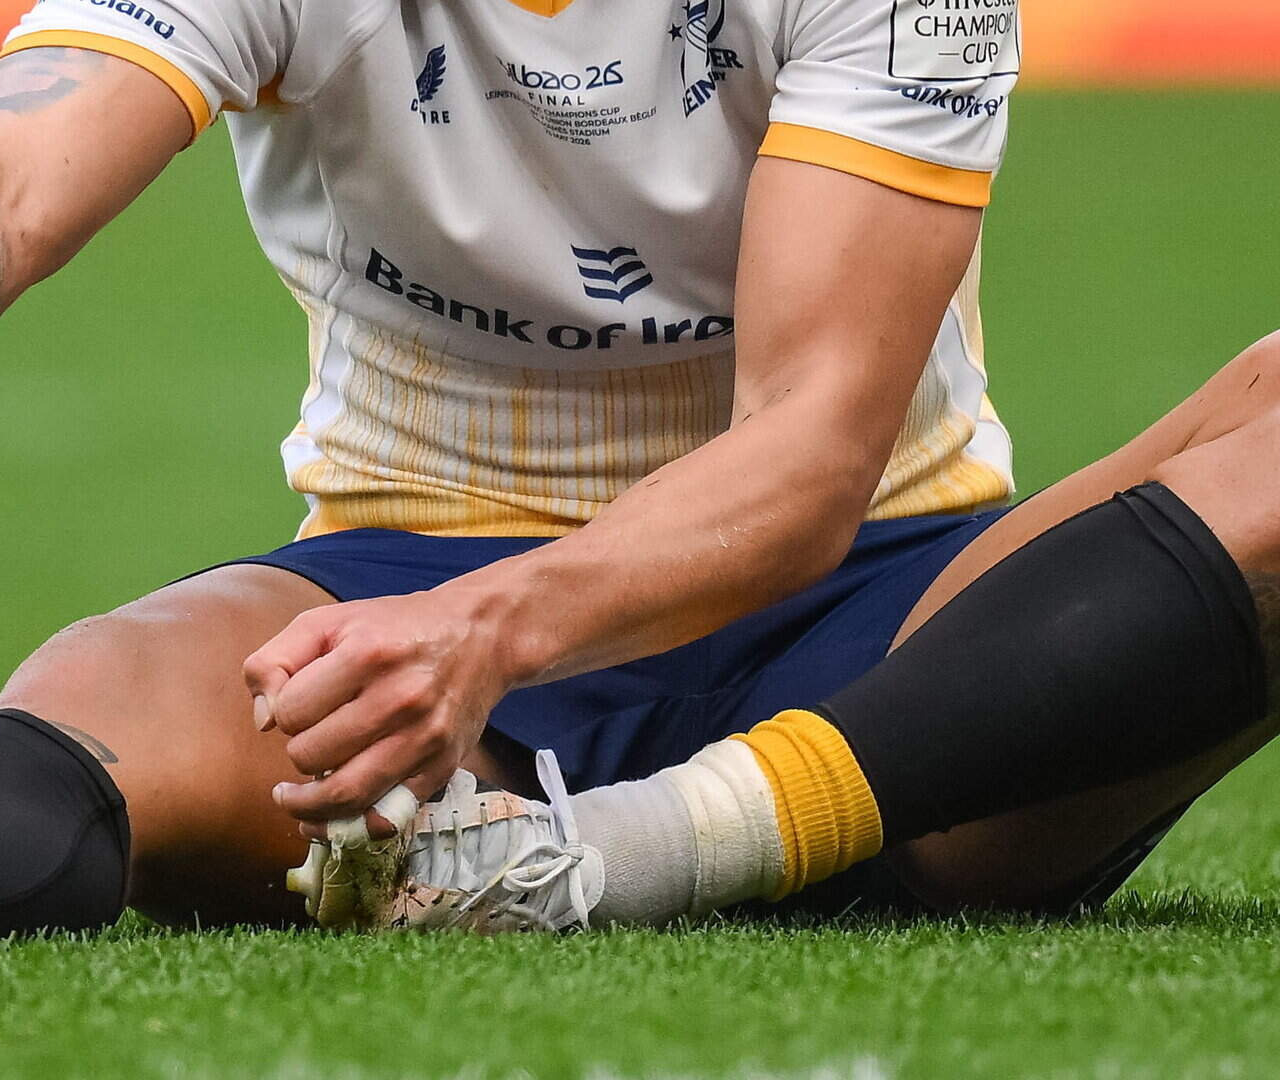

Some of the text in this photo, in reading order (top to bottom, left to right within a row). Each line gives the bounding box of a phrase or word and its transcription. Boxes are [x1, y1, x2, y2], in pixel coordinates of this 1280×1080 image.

[914, 11, 1013, 37] CHAMPIO
[963, 42, 999, 64] CUP
[585, 60, 624, 90] 26
[528, 92, 585, 107] FINAL
[599, 106, 621, 117] CUP
[574, 115, 628, 128] BORDEAUX
[569, 127, 610, 137] STADIUM
[570, 136, 591, 146] 2026
[365, 247, 535, 344] Bank
[546, 322, 626, 350] of
